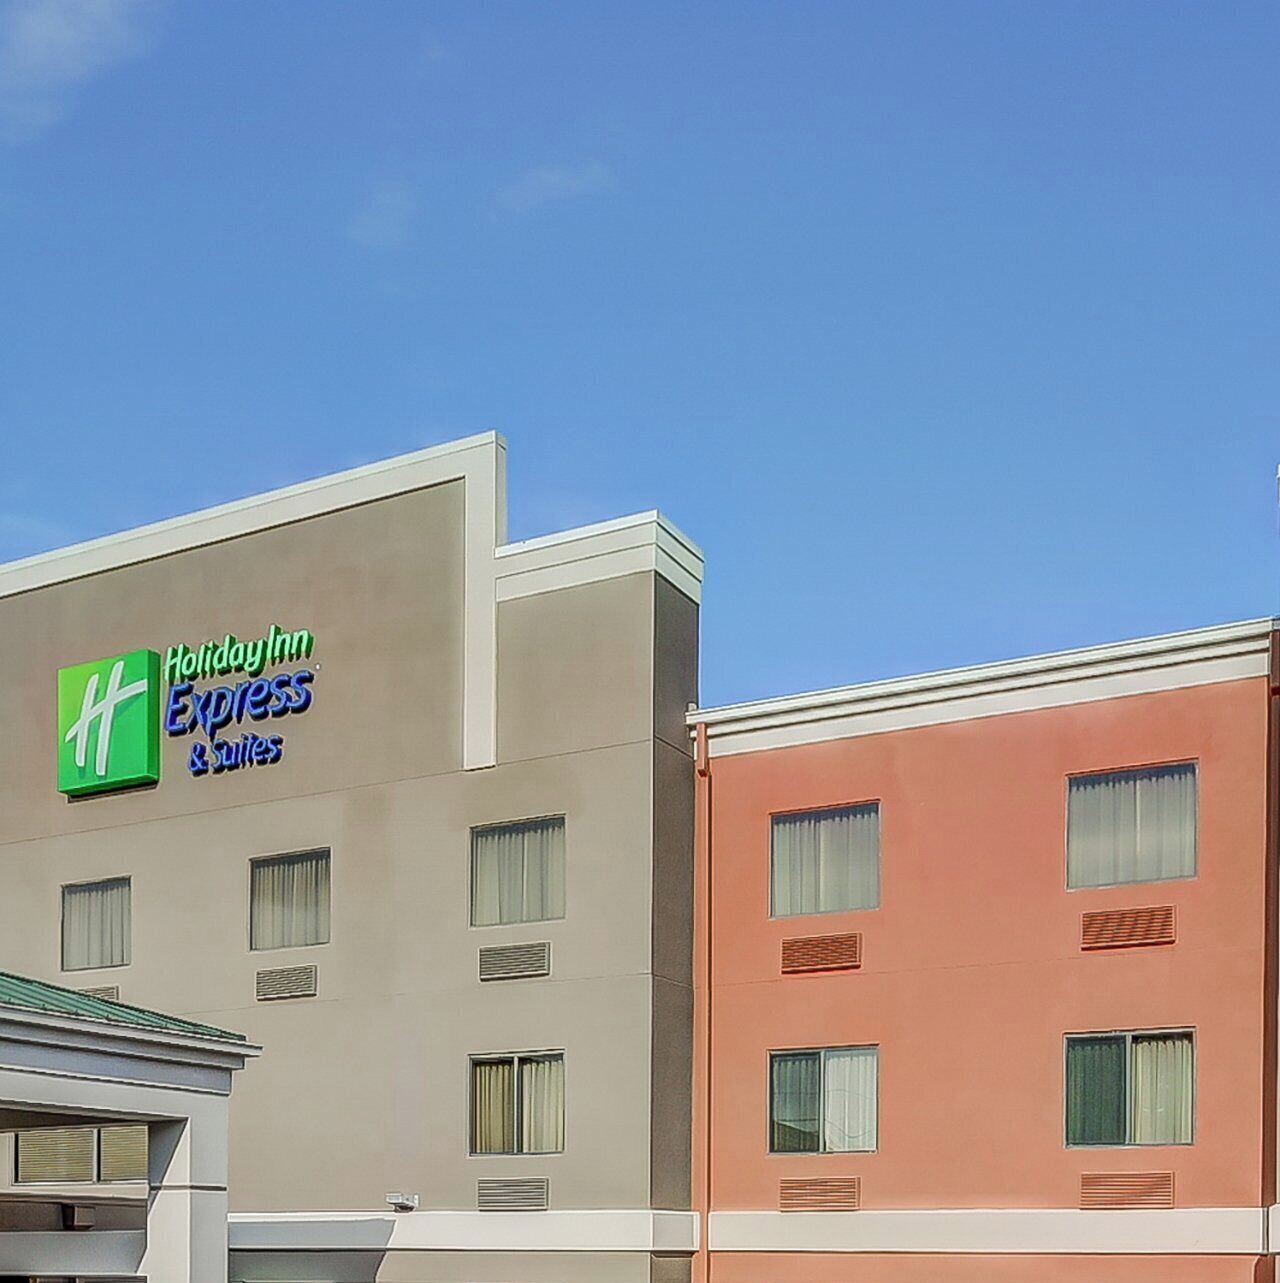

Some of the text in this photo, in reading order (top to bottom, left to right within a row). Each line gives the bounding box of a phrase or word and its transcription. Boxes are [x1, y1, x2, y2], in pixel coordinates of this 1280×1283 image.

[164, 624, 314, 681] Holiday Inn
[164, 669, 315, 740] Express
[187, 731, 284, 777] & Suites
